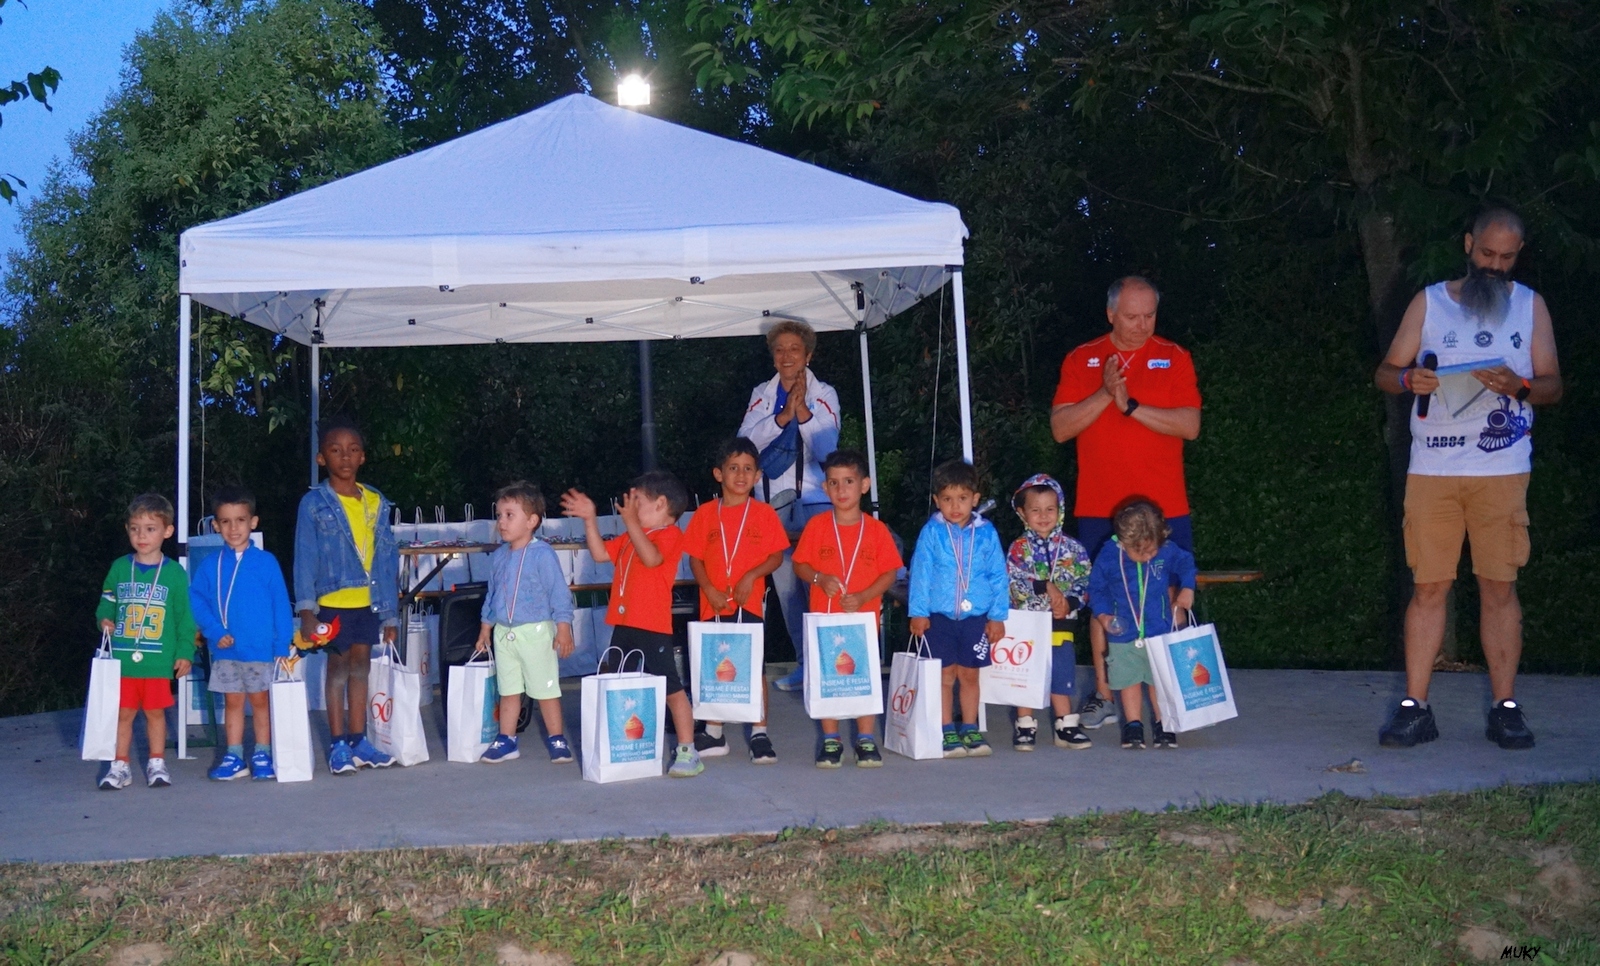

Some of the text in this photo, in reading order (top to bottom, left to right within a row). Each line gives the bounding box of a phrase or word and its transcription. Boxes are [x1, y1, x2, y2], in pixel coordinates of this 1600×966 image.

[117, 582, 169, 602] CHICAGO
[124, 604, 166, 640] 23
[991, 636, 1033, 666] 60
[371, 692, 394, 723] 60
[892, 684, 915, 715] 60
